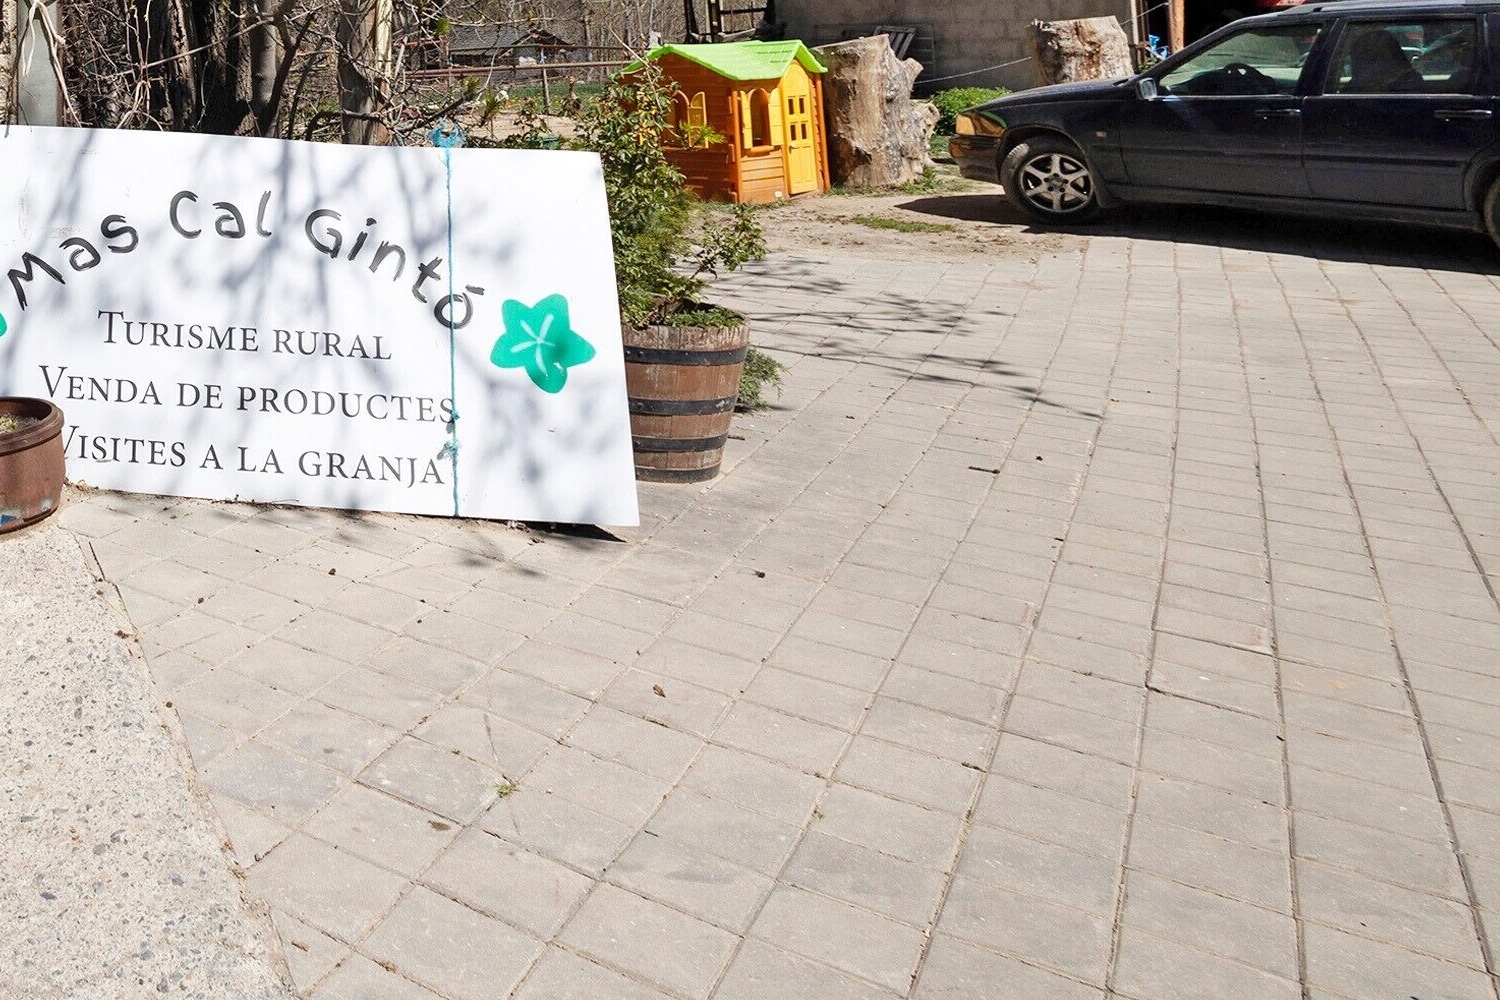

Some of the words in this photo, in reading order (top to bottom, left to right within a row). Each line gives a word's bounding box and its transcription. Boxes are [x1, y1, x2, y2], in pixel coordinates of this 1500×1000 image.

[7, 213, 140, 312] Mas
[169, 189, 273, 240] Cal
[304, 208, 486, 330] Gintó
[97, 310, 260, 352] TURISME
[272, 329, 393, 361] RURAL
[38, 364, 164, 406] VENDA
[176, 382, 224, 410] DE
[236, 385, 455, 425] PRODUCTES
[199, 444, 224, 470] A
[237, 446, 285, 474] LA
[298, 450, 446, 489] GRANJA
